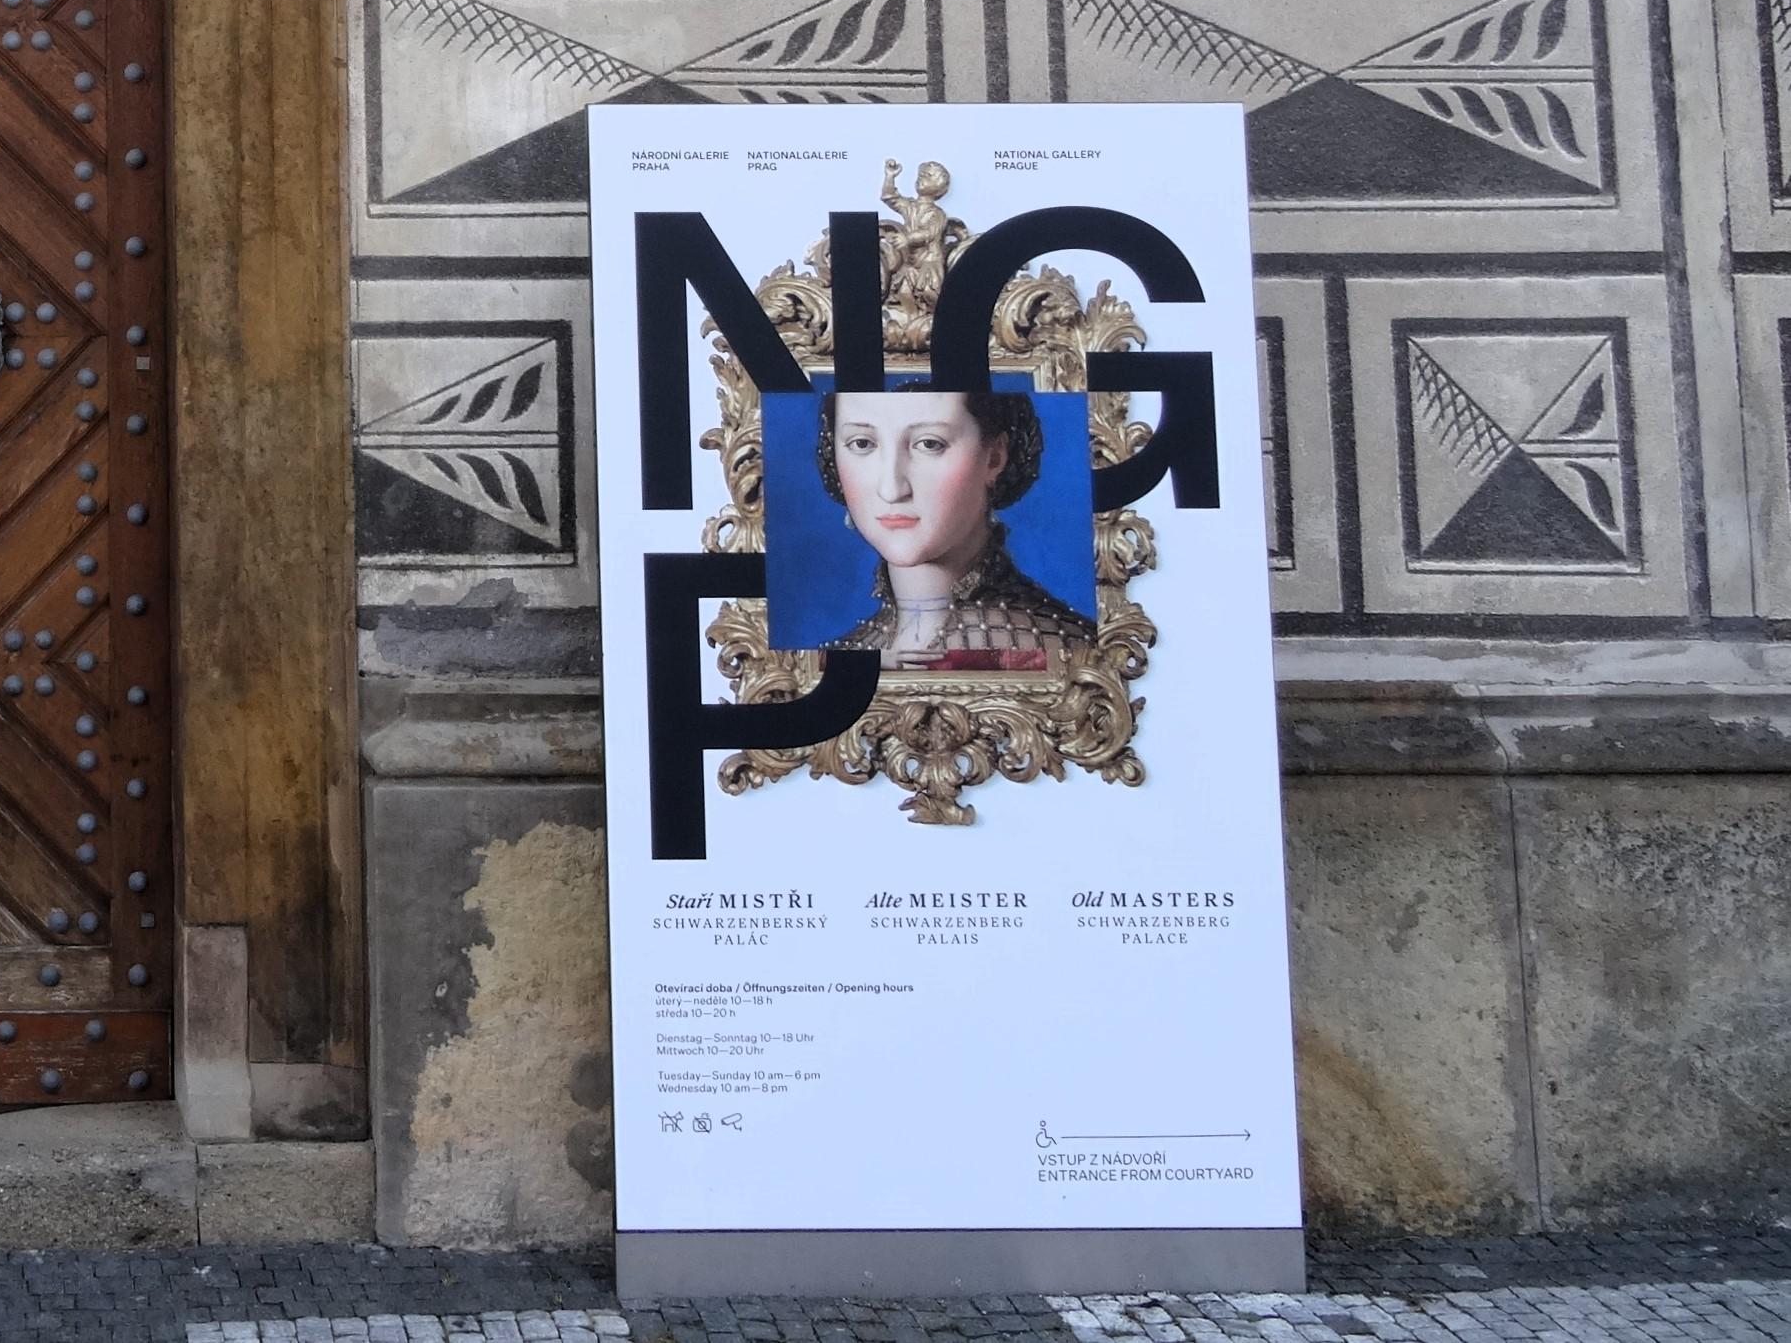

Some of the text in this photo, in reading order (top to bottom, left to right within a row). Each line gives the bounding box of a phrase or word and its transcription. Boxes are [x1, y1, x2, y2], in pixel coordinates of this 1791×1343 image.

[631, 149, 730, 161] NÁRODNÍ GALERIE
[747, 150, 848, 160] NATIONALGALERIE
[994, 149, 1102, 160] NATIONAL GALLERY
[632, 162, 671, 172] PRAHA
[747, 162, 778, 172] PRAG
[994, 161, 1039, 171] PRAGUE
[665, 889, 813, 910] Staří MISTŘI
[864, 891, 1027, 909] Alte MEISTER
[1071, 890, 1235, 908] Old MASTERS
[652, 914, 828, 930] SCHWARZENBERSKÝ
[870, 916, 1024, 929] SCHWARZENBERG
[1077, 915, 1230, 928] SCHWARZENBERG
[714, 930, 769, 946] PALÁC
[917, 933, 979, 945] PALAIS
[1121, 932, 1188, 945] PALACE
[705, 982, 733, 993] doba
[742, 981, 825, 995] Öffnungszeiten
[834, 982, 881, 995] Opening
[882, 982, 914, 993] hours
[766, 995, 773, 1006] h
[655, 1008, 689, 1019] středa
[728, 1008, 736, 1018] h
[795, 1032, 815, 1043] Uhr
[656, 1045, 705, 1056] Mittwoch
[745, 1045, 765, 1056] Uhr
[753, 1069, 766, 1081] 10
[803, 1072, 821, 1082] pm
[657, 1082, 718, 1095] Wednesday
[720, 1082, 733, 1094] 10
[770, 1084, 788, 1095] pm
[1037, 1150, 1166, 1167] VSTUP Z NÁDVOŘÍ
[1038, 1167, 1254, 1183] ENTRANCE FROM COURTYARD
